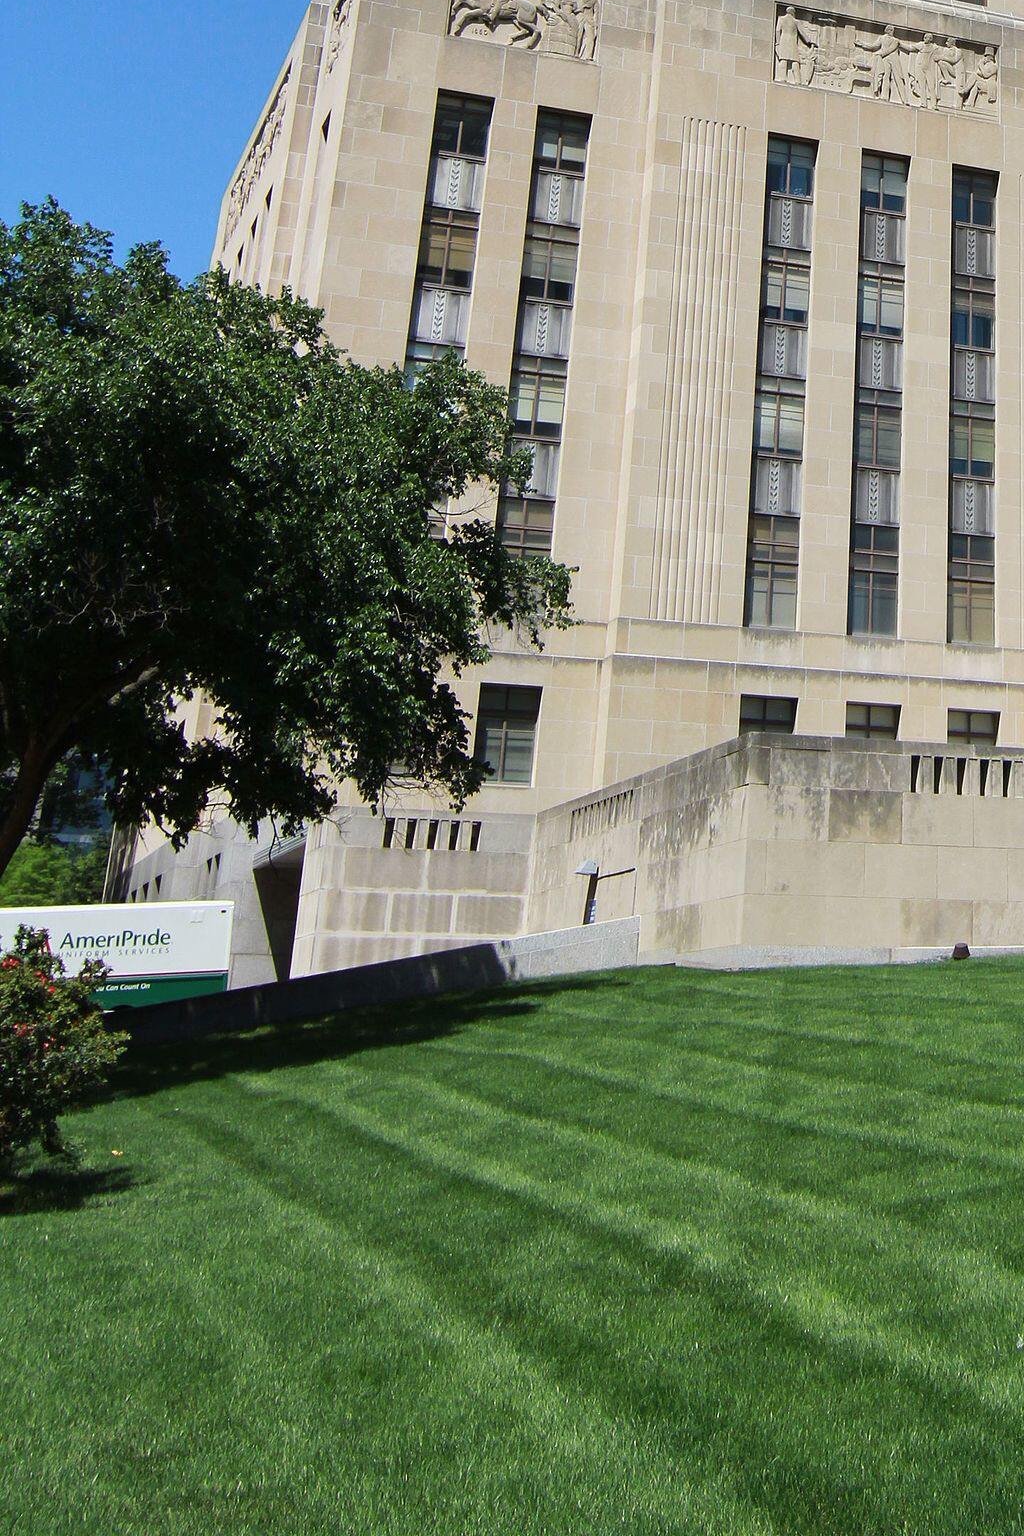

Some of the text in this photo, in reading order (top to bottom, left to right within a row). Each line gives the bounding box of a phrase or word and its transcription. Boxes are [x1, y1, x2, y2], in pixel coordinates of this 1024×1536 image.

[60, 928, 171, 949] AmeriPride
[119, 947, 170, 957] SERVICES
[120, 983, 139, 991] Count
